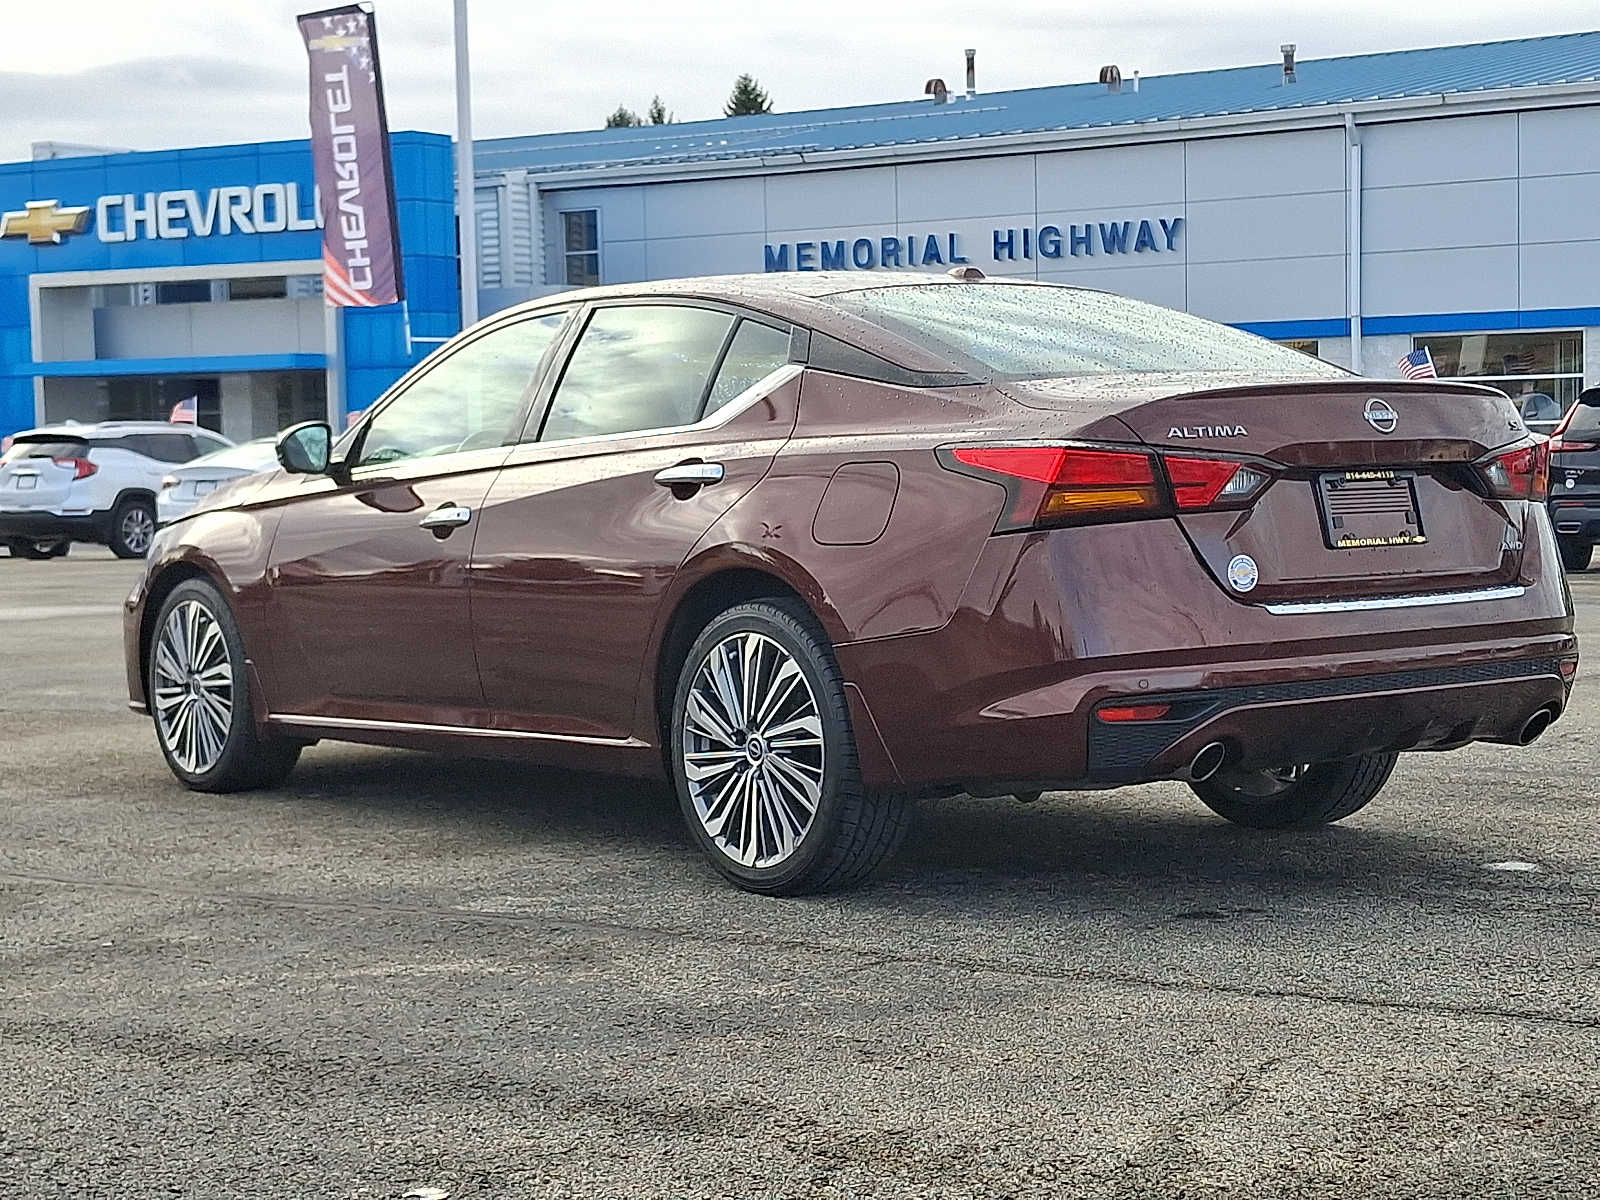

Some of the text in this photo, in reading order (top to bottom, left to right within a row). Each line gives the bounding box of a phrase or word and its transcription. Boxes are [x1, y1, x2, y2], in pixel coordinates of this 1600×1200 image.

[96, 181, 325, 243] CHEVROL
[763, 217, 1184, 272] MEMORIAL HIGHWAY
[1166, 424, 1249, 439] ALTIMA
[1337, 535, 1410, 548] MEMORIAL HWY
[1502, 541, 1524, 550] AWD
